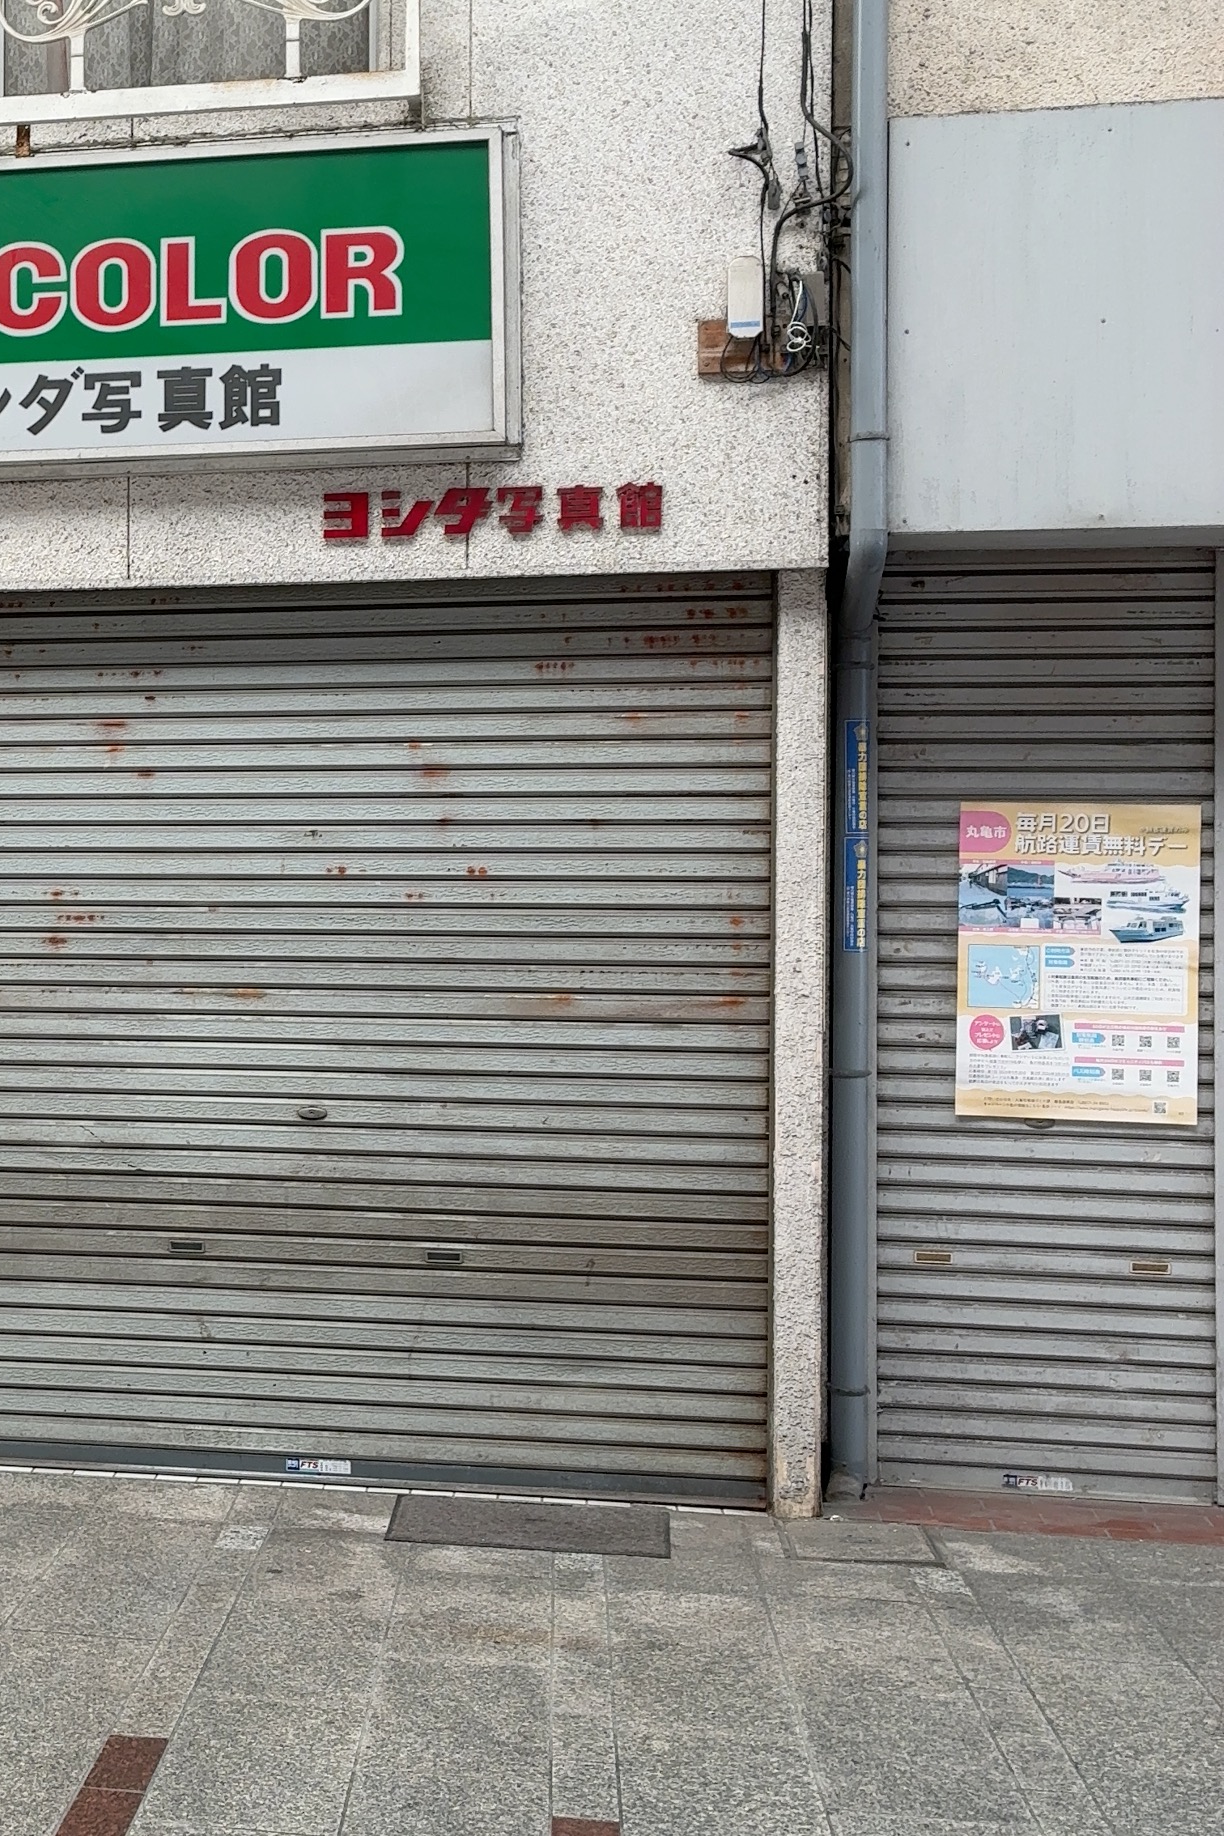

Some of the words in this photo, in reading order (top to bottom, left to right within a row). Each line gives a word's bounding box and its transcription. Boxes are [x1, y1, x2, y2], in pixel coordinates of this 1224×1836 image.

[323, 482, 662, 539] ヨシダ写真館
[1015, 812, 1110, 833] 毎月20日
[965, 825, 1007, 839] 丸亀市
[1014, 834, 1188, 857] 航路運賃無料デー
[300, 1461, 319, 1469] FTS
[1018, 1478, 1038, 1486] FTS
